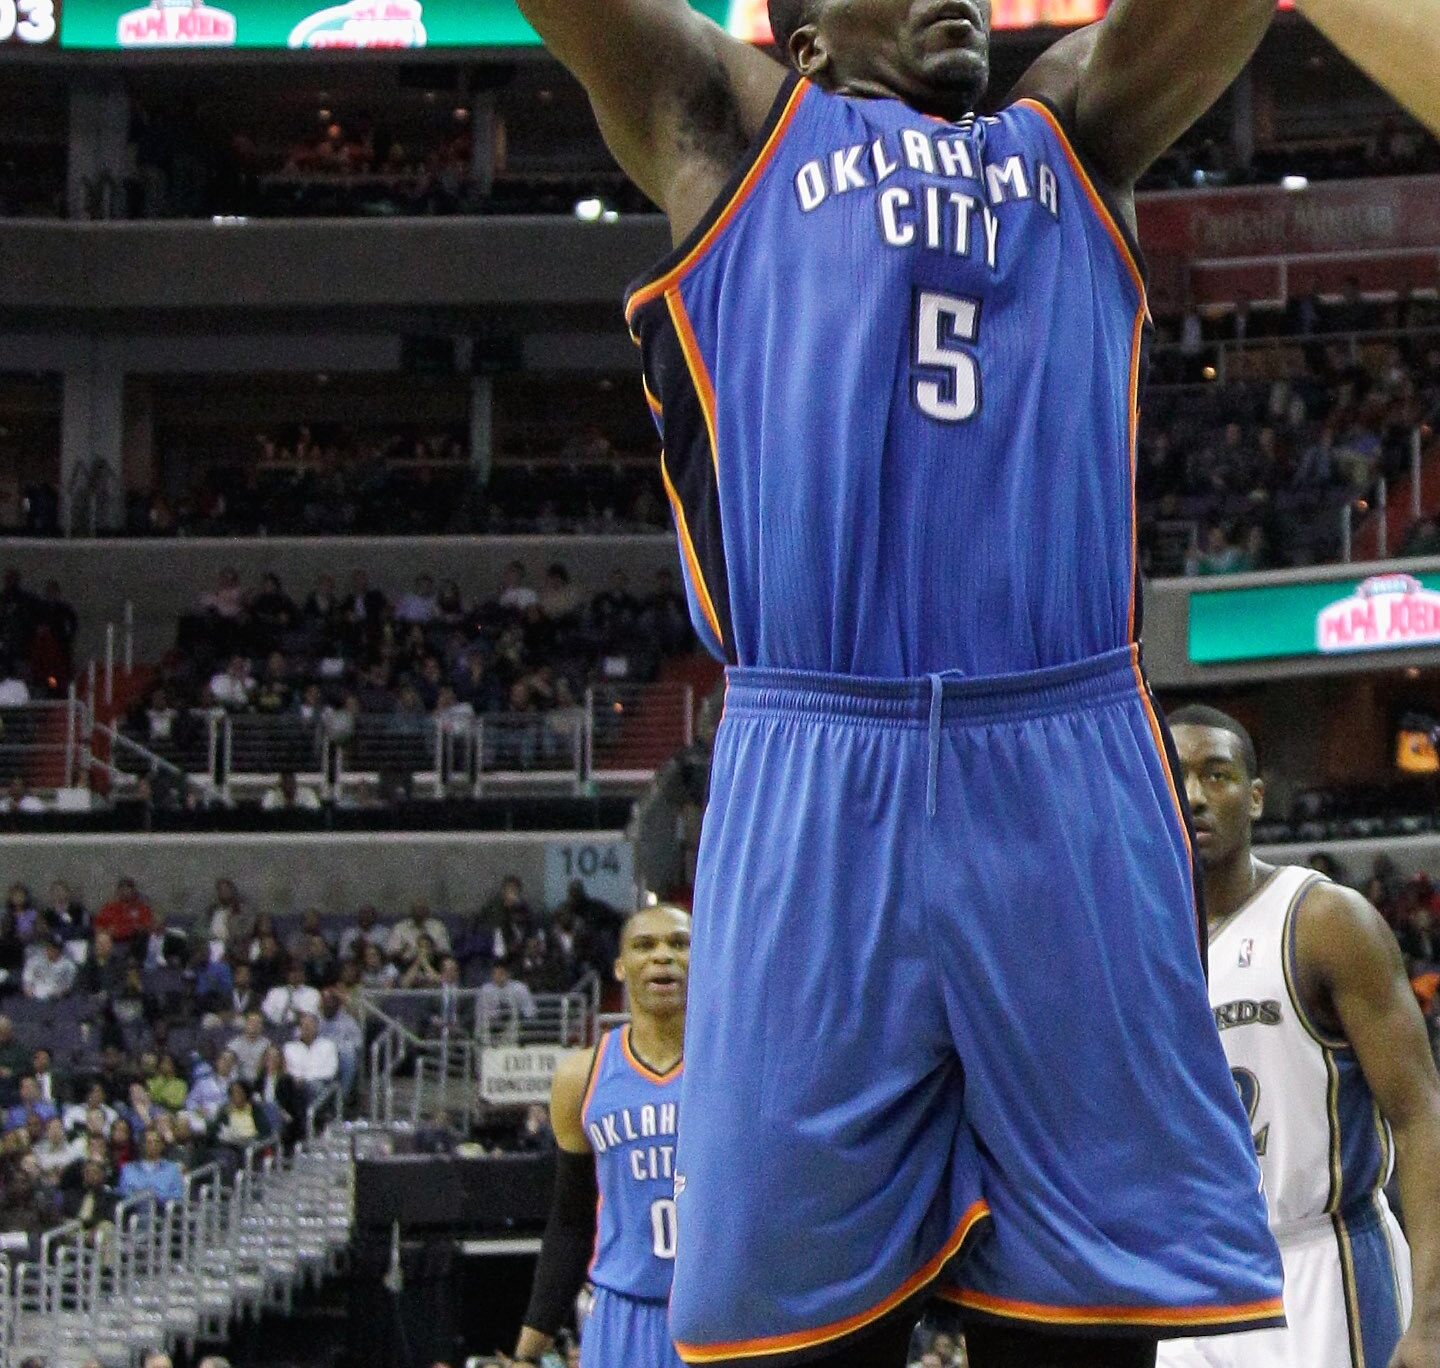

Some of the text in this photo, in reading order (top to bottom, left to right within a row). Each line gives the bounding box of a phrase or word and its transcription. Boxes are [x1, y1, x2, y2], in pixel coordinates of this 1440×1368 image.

[793, 128, 1061, 221] OKLAHOMA
[876, 184, 1001, 271] CITY
[907, 285, 984, 424] 5
[561, 845, 622, 878] 104
[588, 1101, 676, 1154] OKLAH
[629, 1144, 675, 1182] CIT
